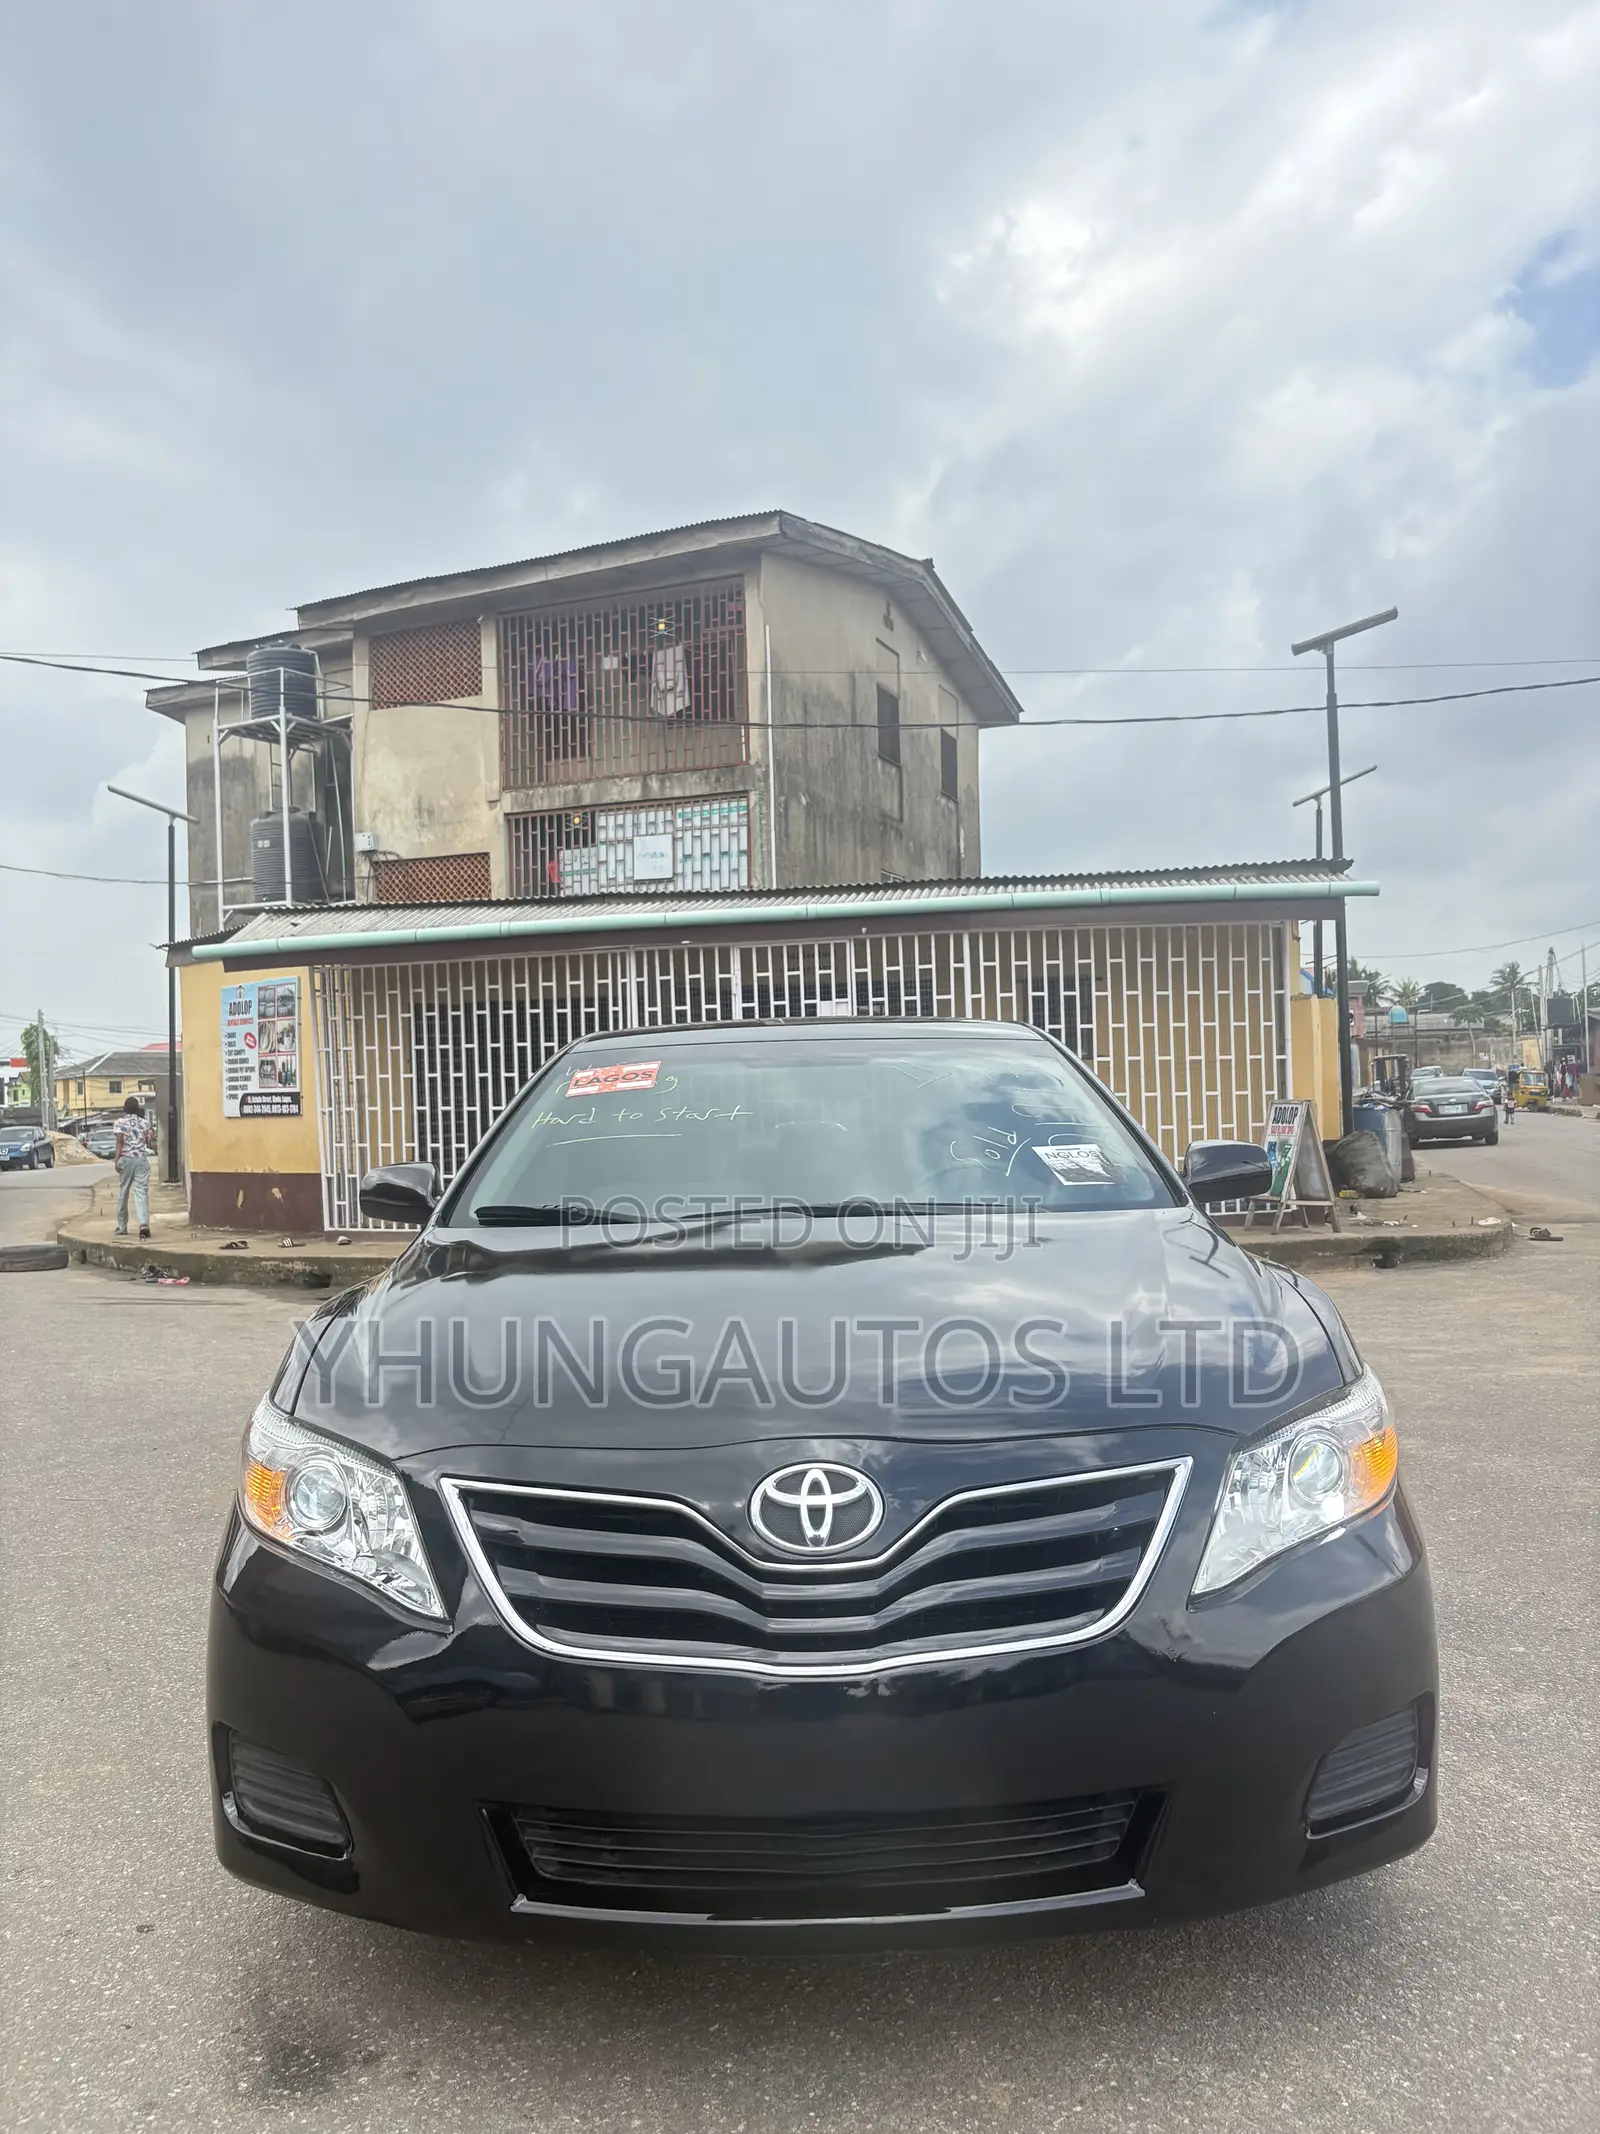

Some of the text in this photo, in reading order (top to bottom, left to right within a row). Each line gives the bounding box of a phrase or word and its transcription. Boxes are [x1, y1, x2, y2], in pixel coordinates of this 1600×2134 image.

[228, 1000, 252, 1016] ADOLOP
[573, 1071, 653, 1087] LAGOS
[532, 1107, 596, 1129] Hard
[612, 1108, 643, 1122] to
[1272, 1106, 1299, 1125] ADOLOP
